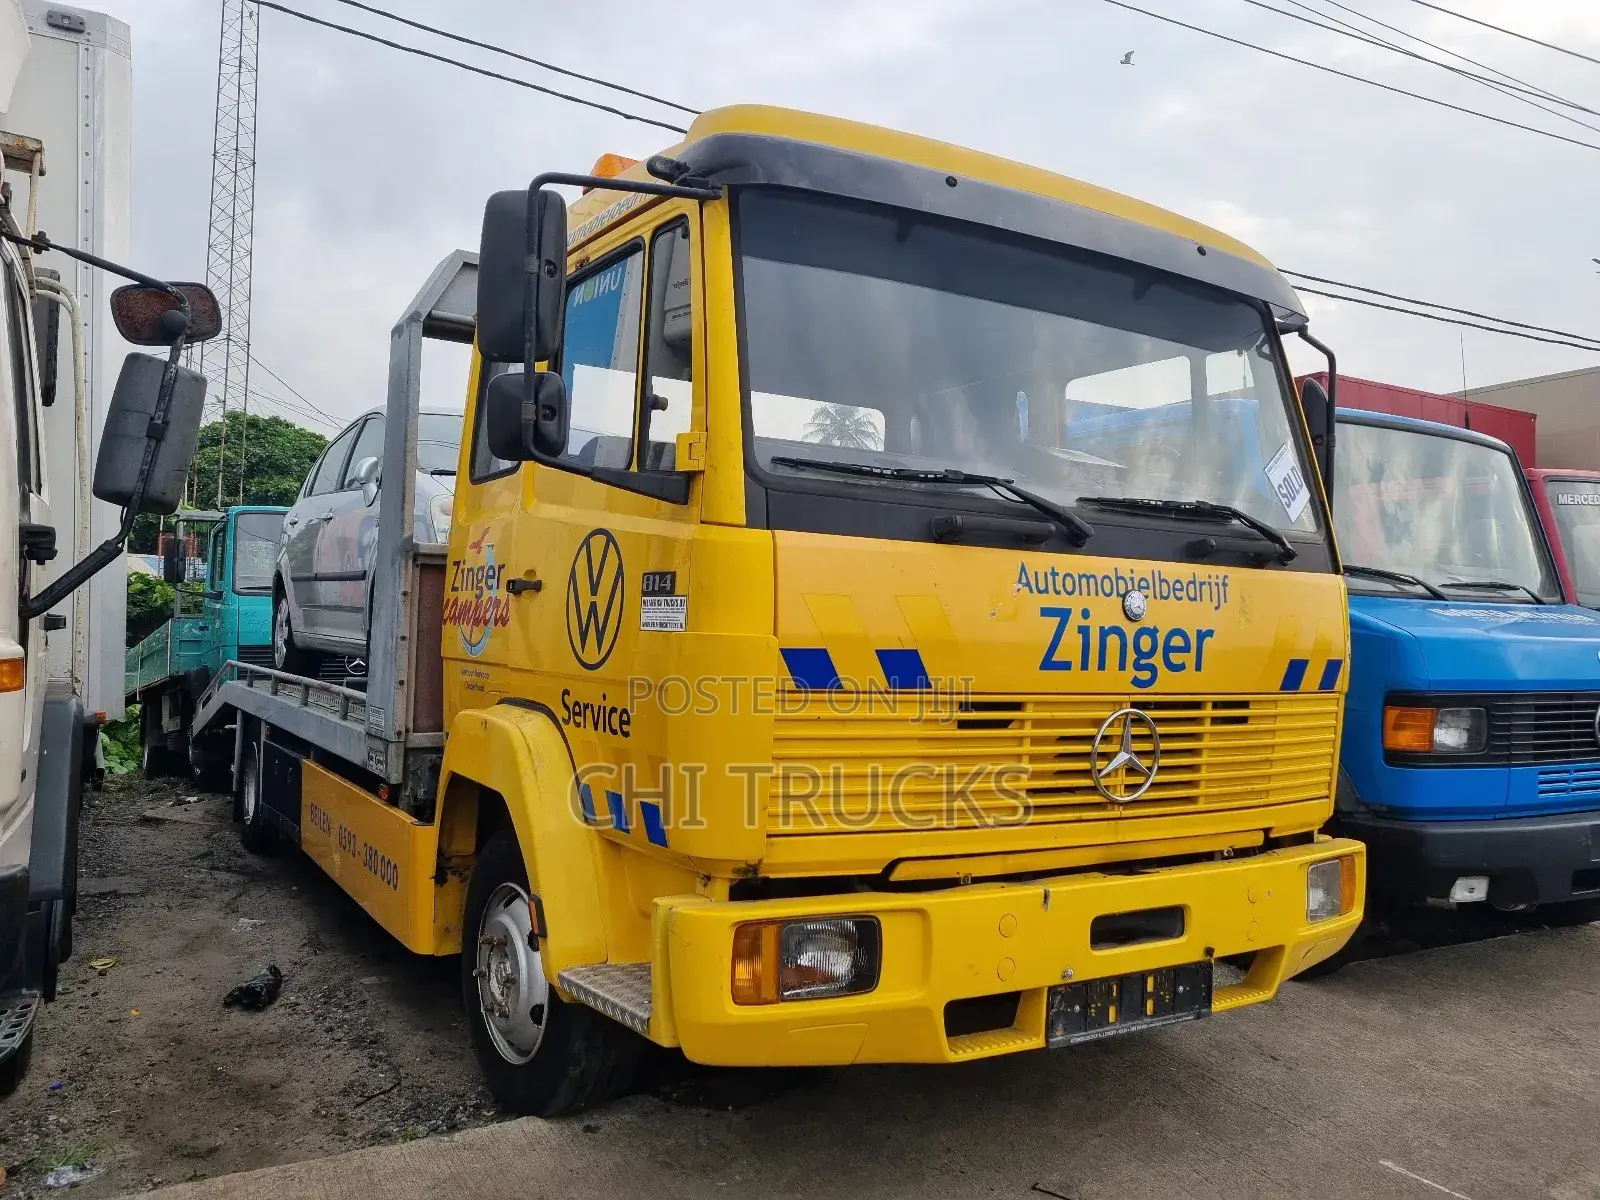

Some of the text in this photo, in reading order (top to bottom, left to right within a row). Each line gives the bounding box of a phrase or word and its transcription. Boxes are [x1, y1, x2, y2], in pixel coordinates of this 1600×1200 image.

[1277, 465, 1304, 509] SOLD
[1557, 493, 1600, 506] MERCED
[450, 559, 506, 600] Zinger
[642, 574, 672, 592] 814
[1016, 561, 1229, 611] Automobielbedrijf
[1038, 606, 1216, 689] Zinger
[561, 687, 632, 739] Service
[310, 802, 331, 837] BEILEN
